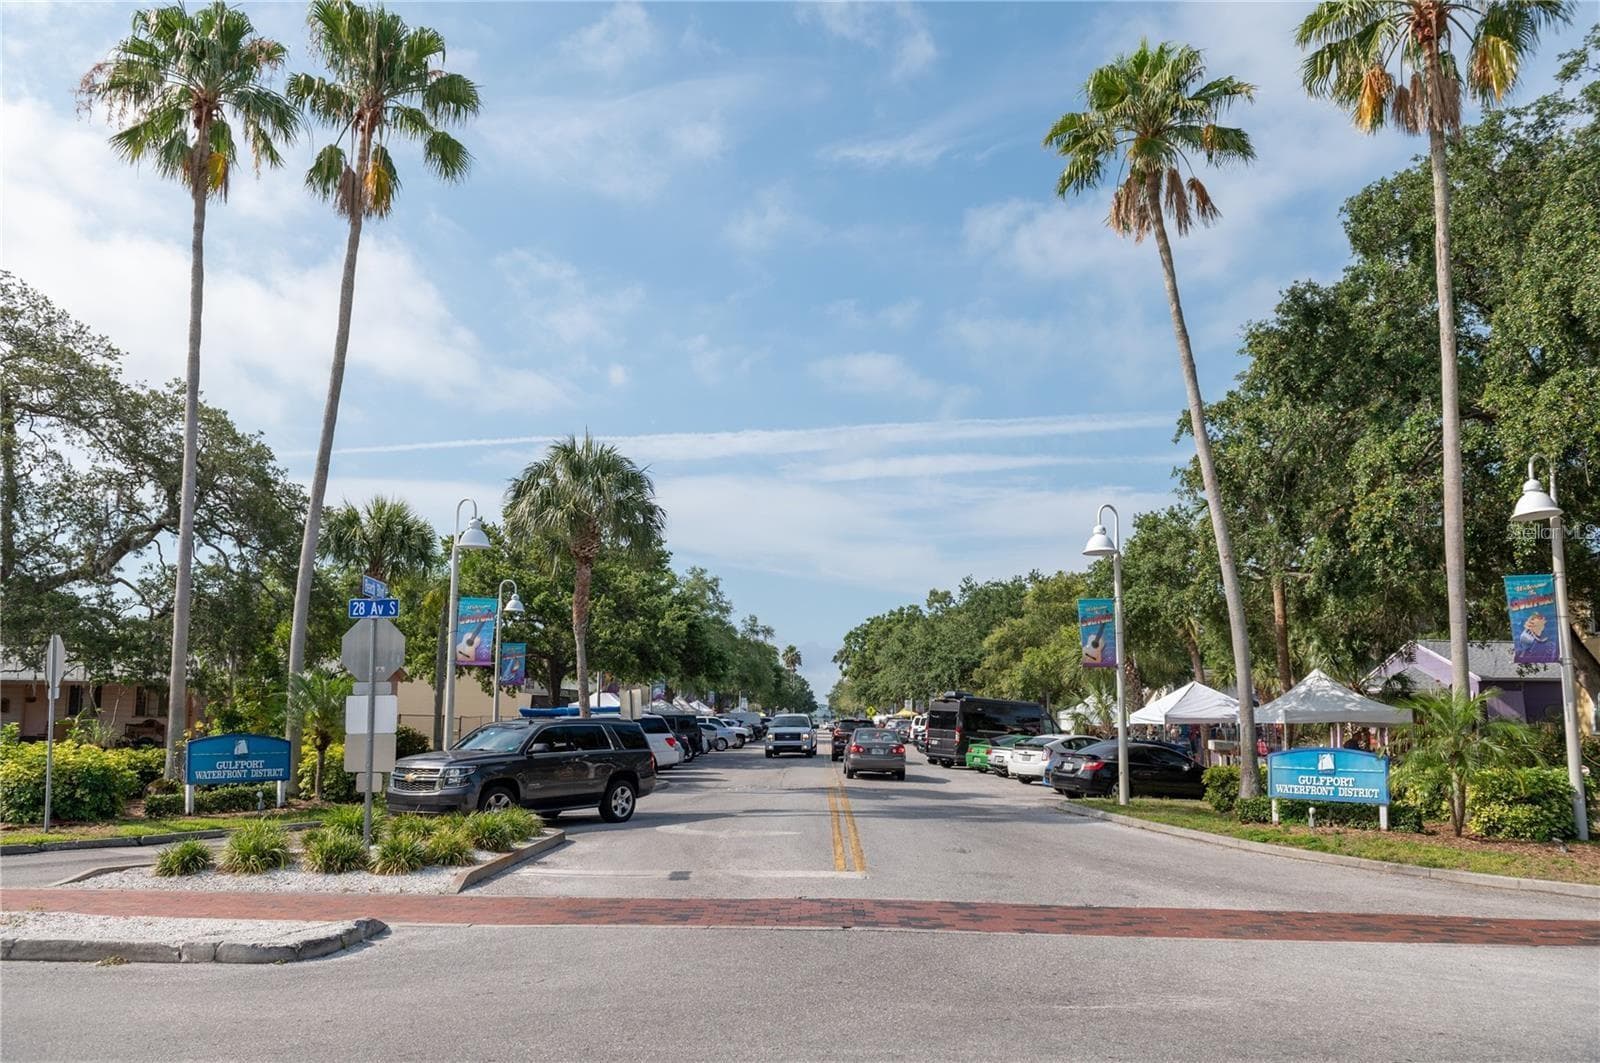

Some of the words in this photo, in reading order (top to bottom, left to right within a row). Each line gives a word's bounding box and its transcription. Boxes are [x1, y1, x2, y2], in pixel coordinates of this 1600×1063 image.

[352, 601, 365, 616] 28
[370, 601, 384, 616] Av
[389, 601, 396, 615] S
[216, 760, 264, 770] GULFPORT
[195, 769, 247, 779] WATERFRONT
[250, 768, 284, 778] DISTRICT
[1298, 775, 1355, 787] GULFPORT
[1275, 784, 1335, 796] WATERFRONT
[1338, 787, 1380, 798] DISTRICT
